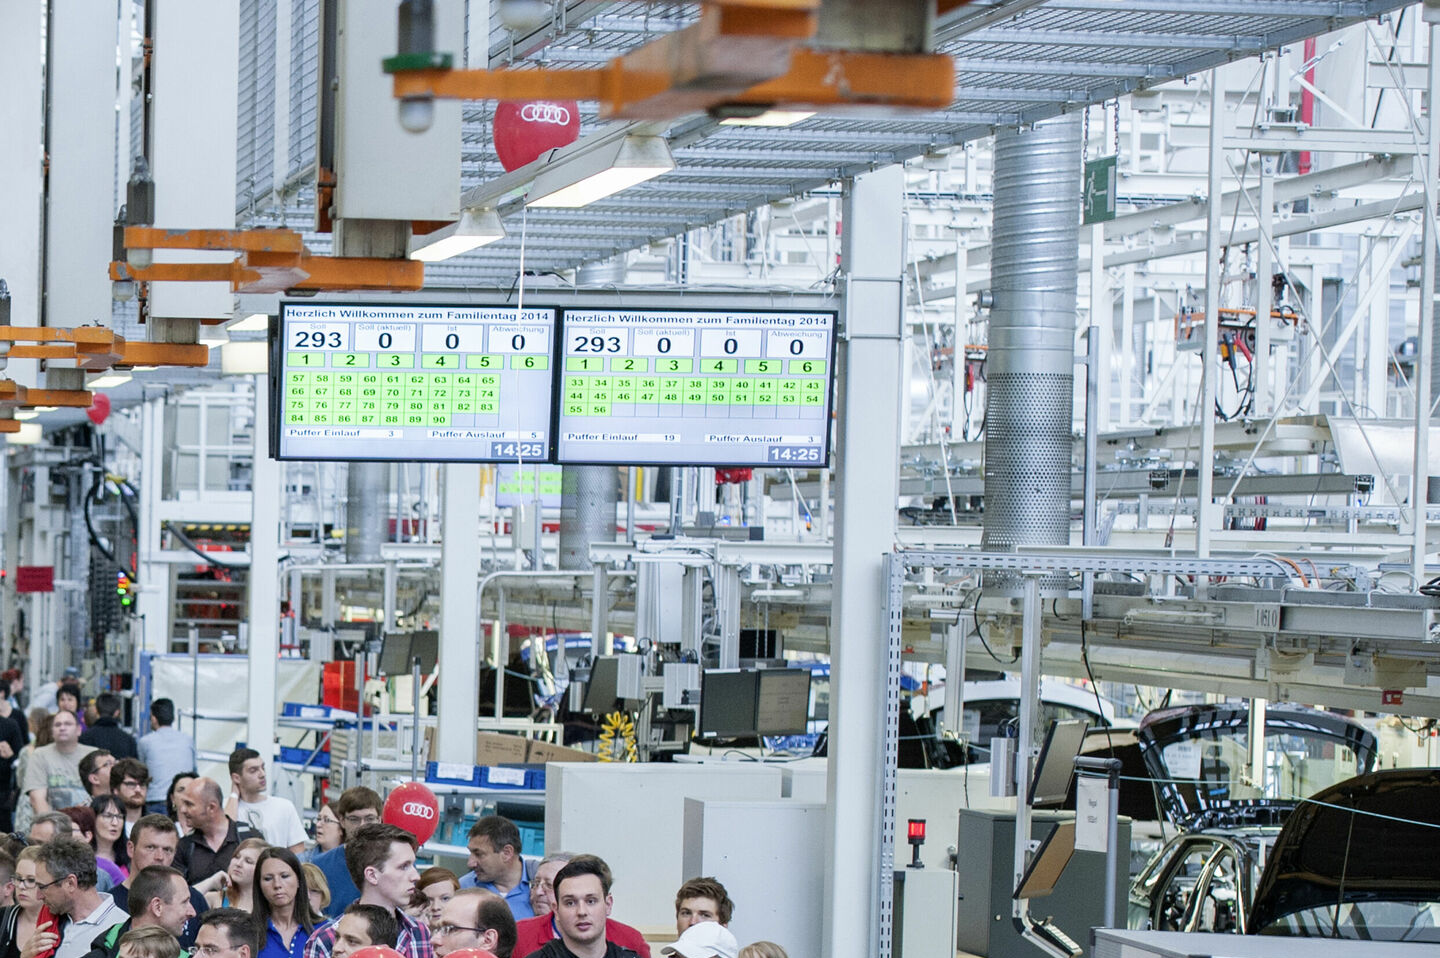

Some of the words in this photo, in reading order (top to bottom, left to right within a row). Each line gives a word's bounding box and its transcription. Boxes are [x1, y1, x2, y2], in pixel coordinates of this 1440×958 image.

[287, 309, 335, 318] Herzlich
[341, 310, 414, 319] Willkommen
[447, 311, 517, 321] Familientag
[521, 312, 548, 320] 2014
[566, 314, 615, 323] Herzlich
[620, 316, 692, 324] Willkommen
[726, 316, 795, 326] Familientag
[800, 317, 827, 325] 2014
[295, 332, 342, 347] 293
[379, 333, 392, 348] 0
[446, 334, 459, 349] 0
[512, 335, 525, 350] 0
[574, 337, 621, 352] 293
[657, 338, 671, 353] 0
[724, 339, 738, 354] 0
[790, 340, 804, 355] 0
[302, 355, 309, 365] 1
[346, 355, 355, 365] 2
[391, 356, 400, 366] 3
[436, 356, 445, 366] 4
[481, 357, 489, 367] 5
[525, 357, 534, 367] 6
[581, 360, 587, 369] 1
[625, 360, 633, 370] 2
[670, 361, 679, 370] 3
[714, 361, 723, 371] 4
[759, 362, 768, 371] 5
[803, 362, 812, 372] 6
[292, 374, 305, 382] 57
[340, 375, 352, 383] 59
[364, 375, 376, 383] 60
[387, 375, 399, 383] 61
[411, 376, 424, 384] 62
[434, 376, 447, 384] 63
[458, 376, 470, 384] 64
[482, 377, 494, 385] 65
[571, 379, 584, 387] 33
[594, 379, 607, 387] 34
[642, 380, 655, 388] 36
[665, 380, 678, 388] 37
[712, 381, 725, 389] 39
[736, 381, 748, 389] 40
[759, 381, 772, 389] 41
[806, 382, 819, 390] 43
[292, 387, 304, 395] 66
[315, 388, 327, 396] 67
[339, 388, 351, 396] 68
[363, 388, 376, 396] 69
[387, 389, 399, 397] 70
[411, 389, 423, 397] 71
[434, 389, 446, 397] 72
[458, 390, 470, 398] 73
[481, 390, 493, 398] 74
[570, 392, 583, 400] 44
[594, 392, 606, 400] 45
[617, 393, 630, 401] 46
[641, 393, 654, 401] 47
[664, 393, 677, 401] 48
[712, 394, 724, 402] 50
[735, 394, 747, 402] 51
[782, 395, 795, 403] 53
[805, 395, 818, 403] 54
[291, 400, 304, 408] 75
[315, 401, 327, 409] 76
[339, 401, 351, 409] 77
[386, 402, 399, 410] 79
[410, 402, 422, 410] 80
[433, 403, 445, 411] 81
[457, 403, 470, 411] 82
[481, 403, 493, 411] 83
[570, 405, 582, 413] 55
[594, 406, 606, 414] 56
[291, 414, 303, 422] 84
[315, 415, 327, 423] 85
[338, 415, 350, 423] 86
[362, 415, 374, 423] 87
[385, 415, 398, 423] 88
[410, 416, 422, 424] 89
[432, 416, 445, 424] 90
[290, 429, 321, 437] Puffer
[710, 435, 740, 443] Puffer
[494, 443, 542, 456] 14:25
[772, 448, 818, 460] 14:25
